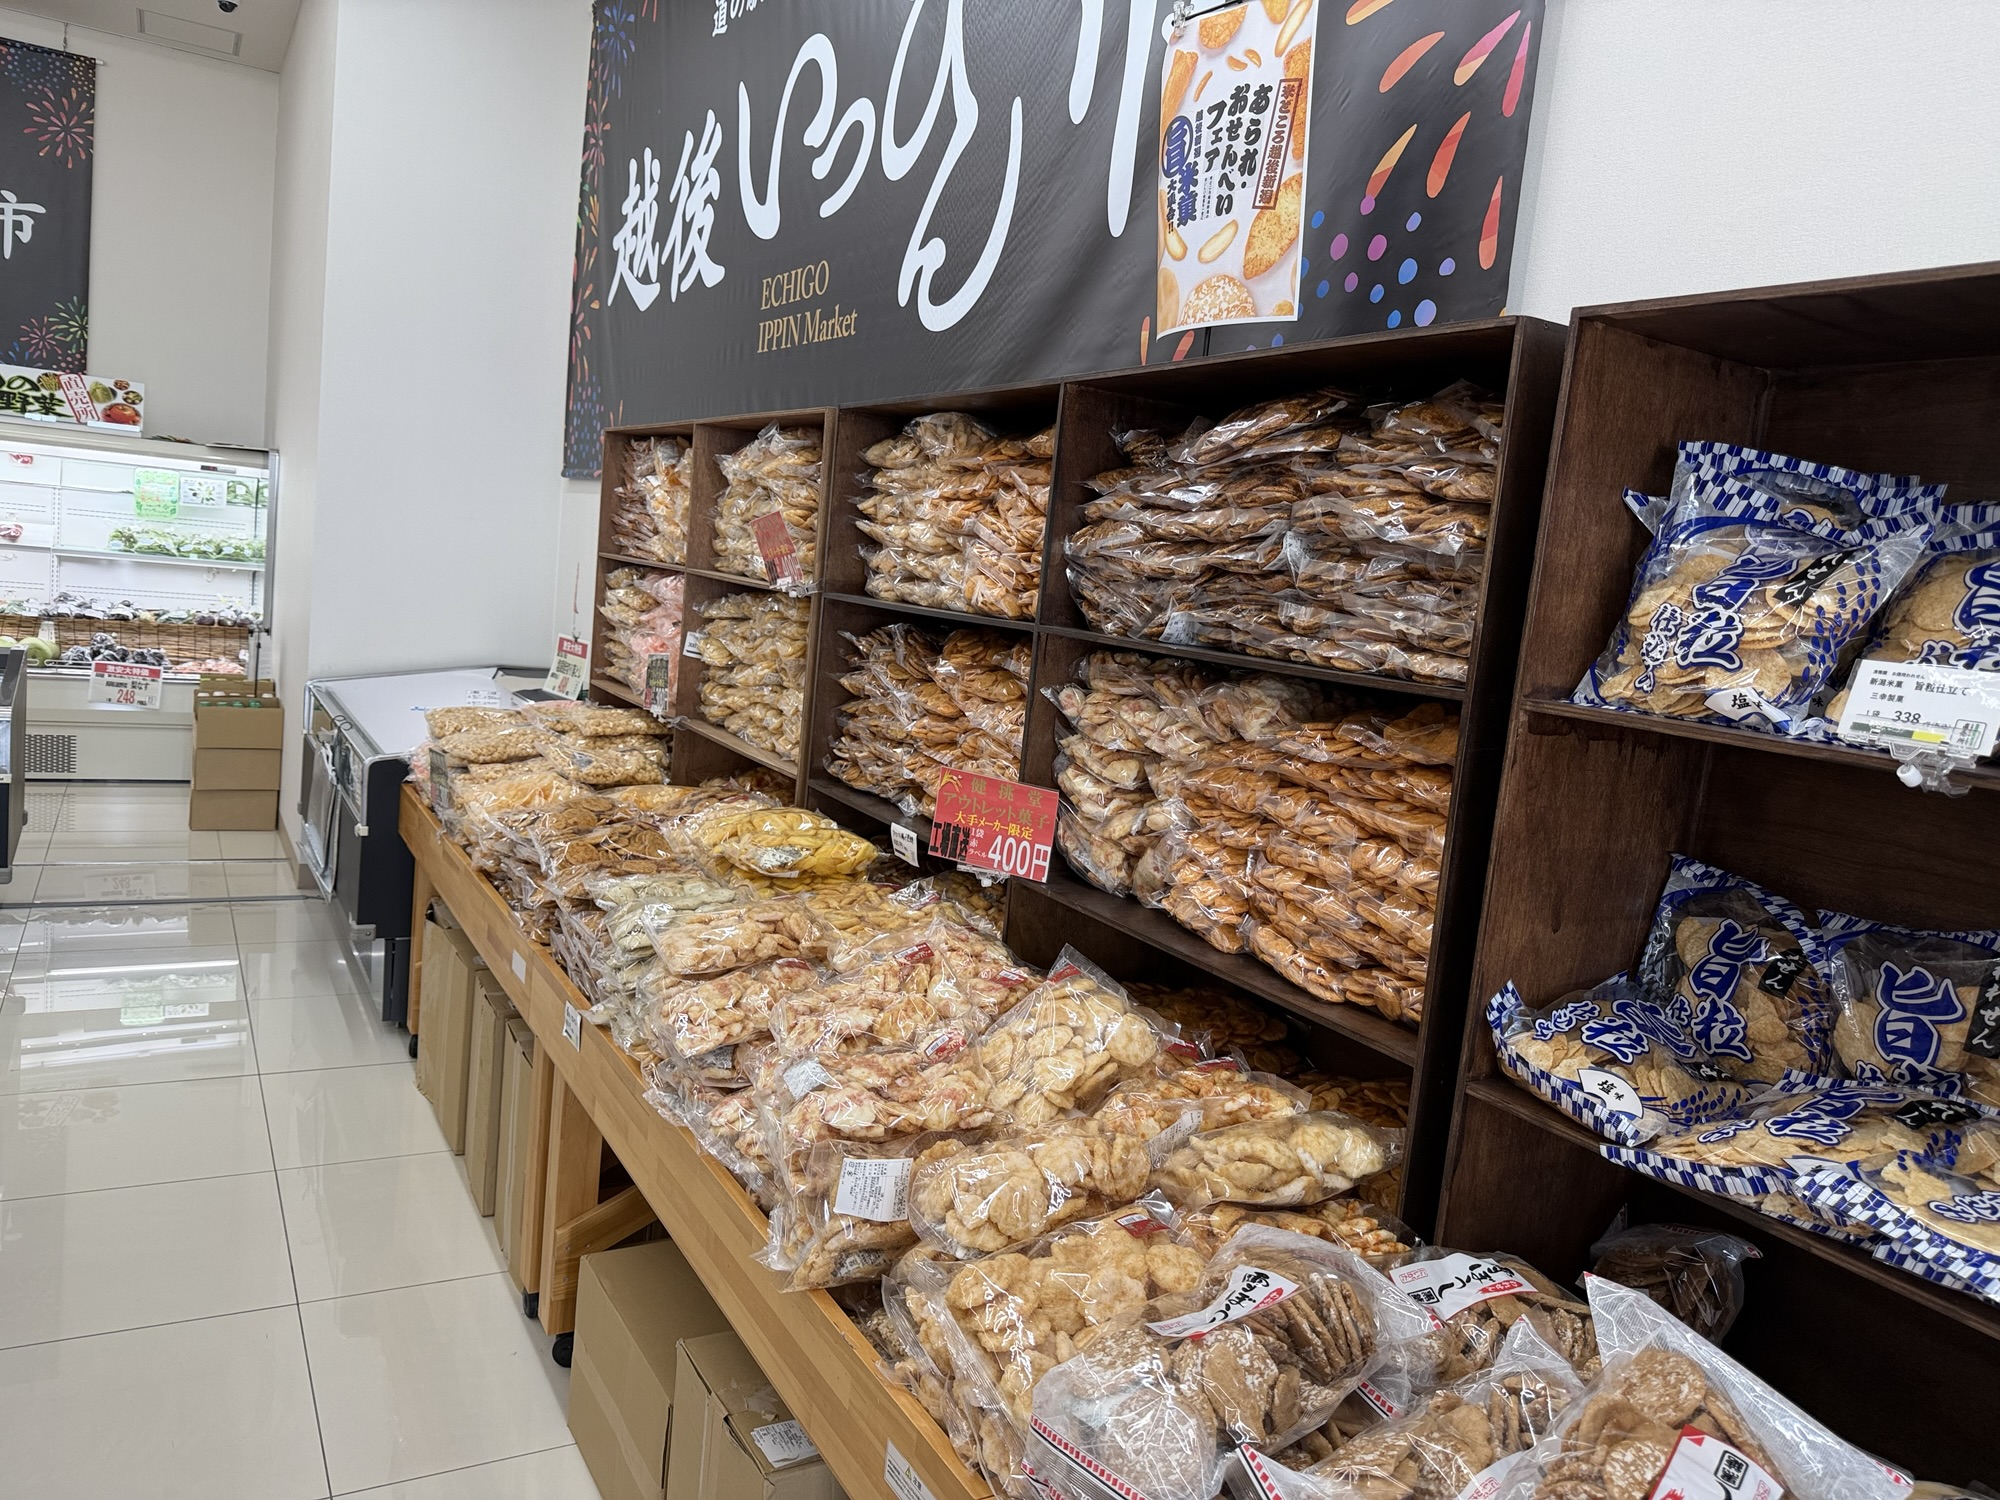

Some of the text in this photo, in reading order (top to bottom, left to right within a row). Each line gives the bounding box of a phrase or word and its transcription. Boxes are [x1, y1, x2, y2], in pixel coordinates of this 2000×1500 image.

[1204, 99, 1228, 173] フェア
[1215, 83, 1251, 217] おせんべい
[1258, 84, 1296, 205] 米どころ越後新潟
[607, 109, 725, 311] 越後
[760, 259, 830, 311] ECHIGO
[756, 303, 858, 354] IPPIN Market
[62, 375, 96, 420] 直売所
[116, 688, 136, 705] 248
[1869, 677, 1971, 696] 新潟米菓 旨粒仕立て
[1869, 692, 1905, 703] 三幸製菓
[1893, 710, 1921, 725] 338
[943, 791, 1051, 830] アウトレット菓子
[954, 810, 1034, 841] 大手メーカー限定
[967, 848, 988, 858] ラベル
[987, 834, 1052, 883] 400円
